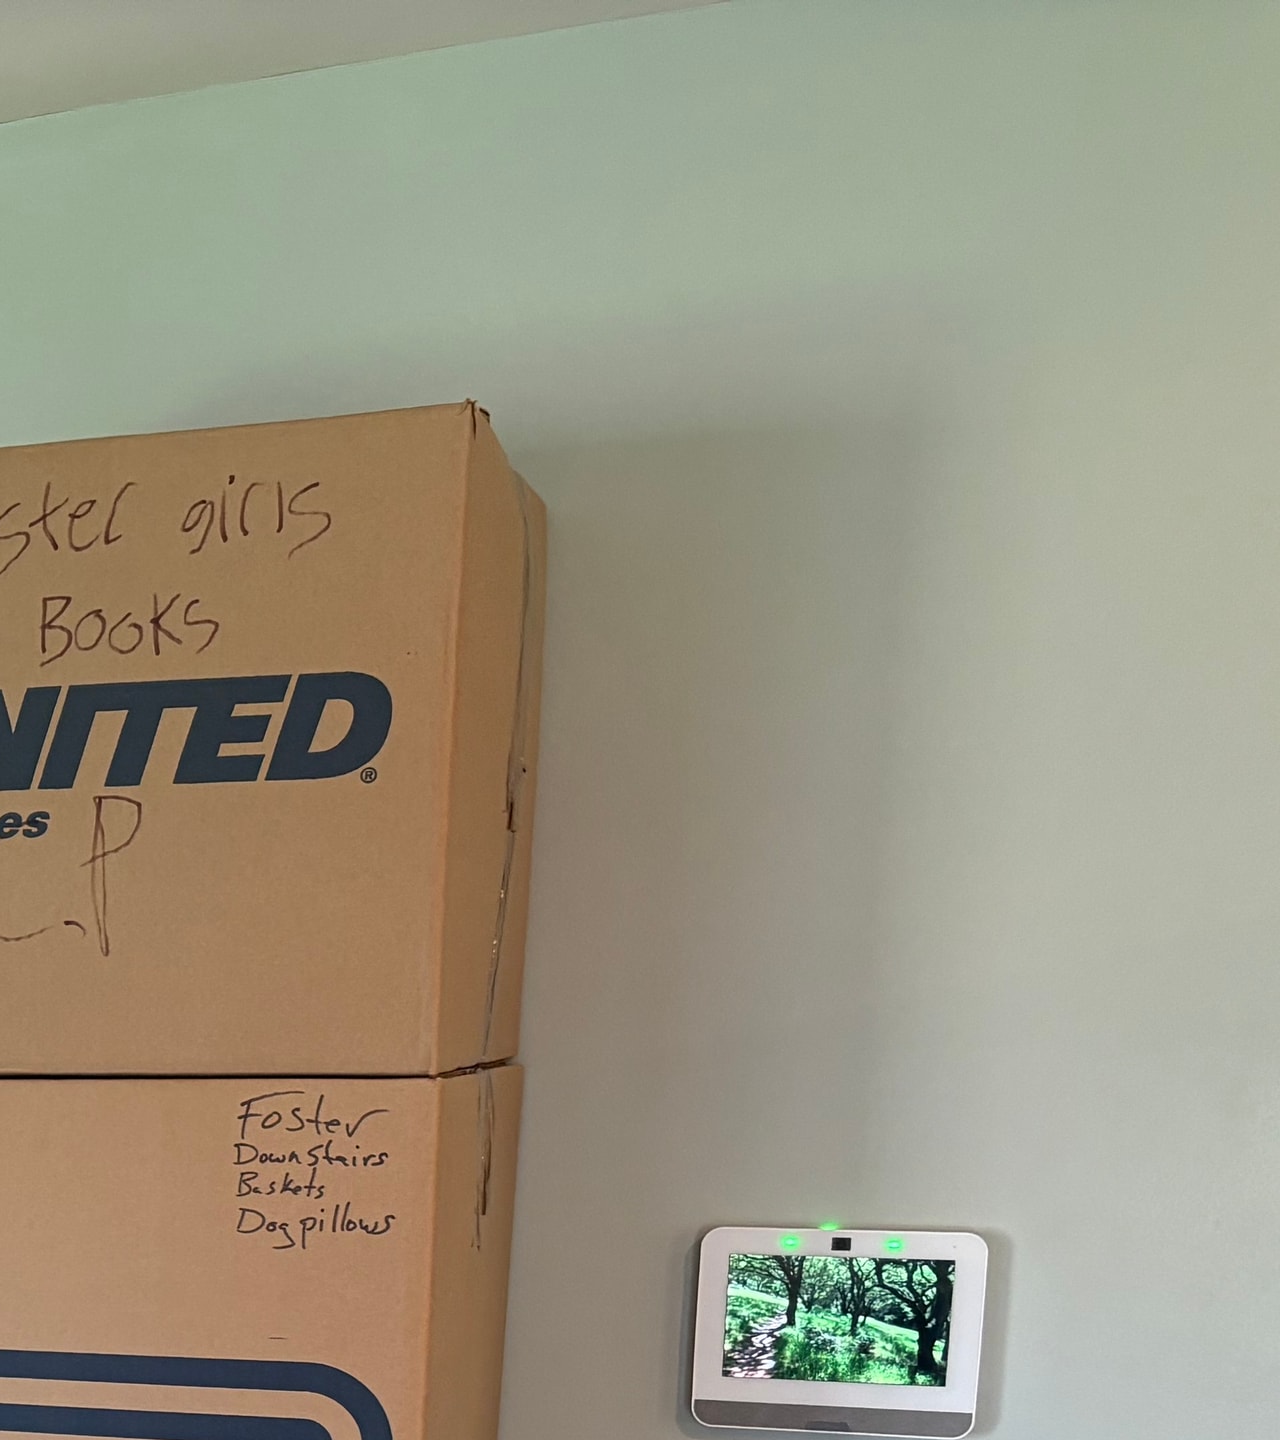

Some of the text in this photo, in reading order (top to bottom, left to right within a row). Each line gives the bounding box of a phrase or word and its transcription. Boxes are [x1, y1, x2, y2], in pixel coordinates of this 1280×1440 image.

[181, 474, 332, 560] girls
[237, 1090, 391, 1140] Foster
[235, 1167, 326, 1200] Baskets
